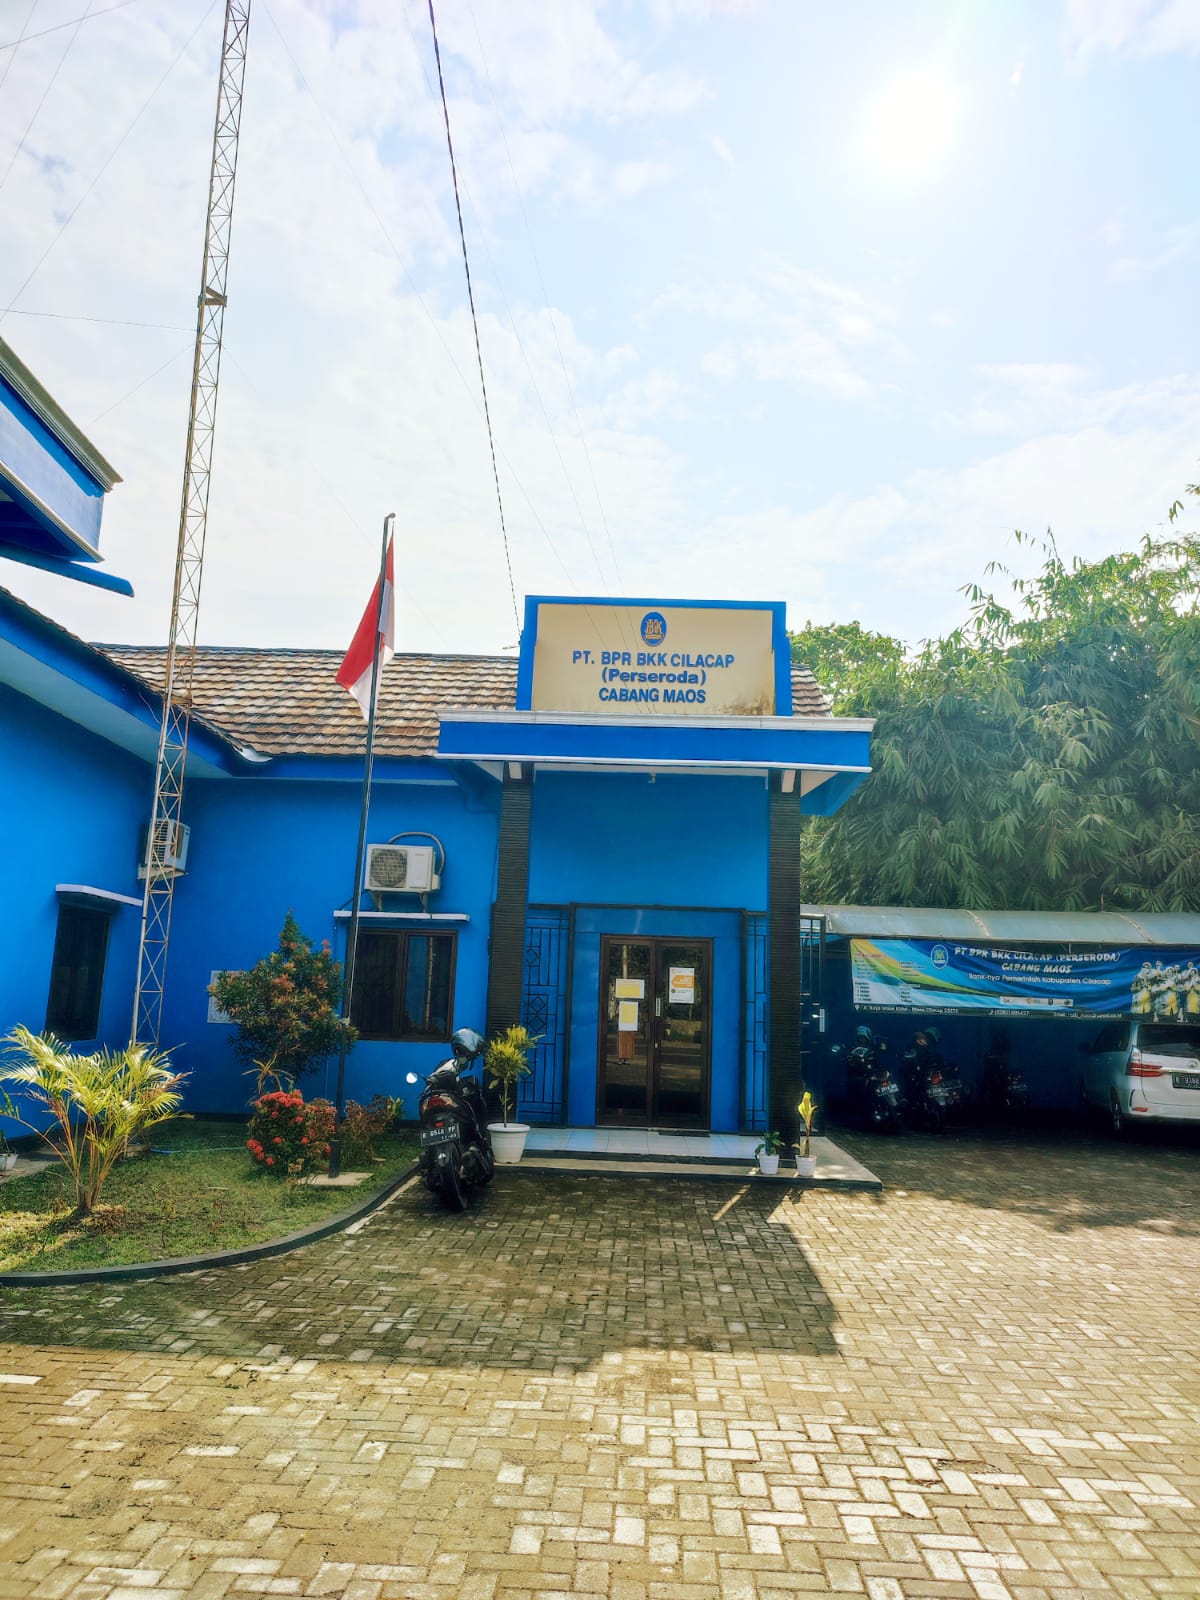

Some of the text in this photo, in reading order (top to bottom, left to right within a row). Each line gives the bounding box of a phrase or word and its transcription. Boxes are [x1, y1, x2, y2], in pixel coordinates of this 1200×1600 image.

[572, 650, 735, 669] PT. BPR BKK CILACAP
[601, 667, 707, 686] (Perseroda)
[598, 687, 706, 704] CABANG MAOS
[954, 946, 1121, 963] PT BPR BKK CILACAP (PERSERODA)
[1001, 962, 1073, 974] CABANG MAOS
[968, 972, 1111, 986] Bank-nya Pemerintah Kabupaten Cilacap
